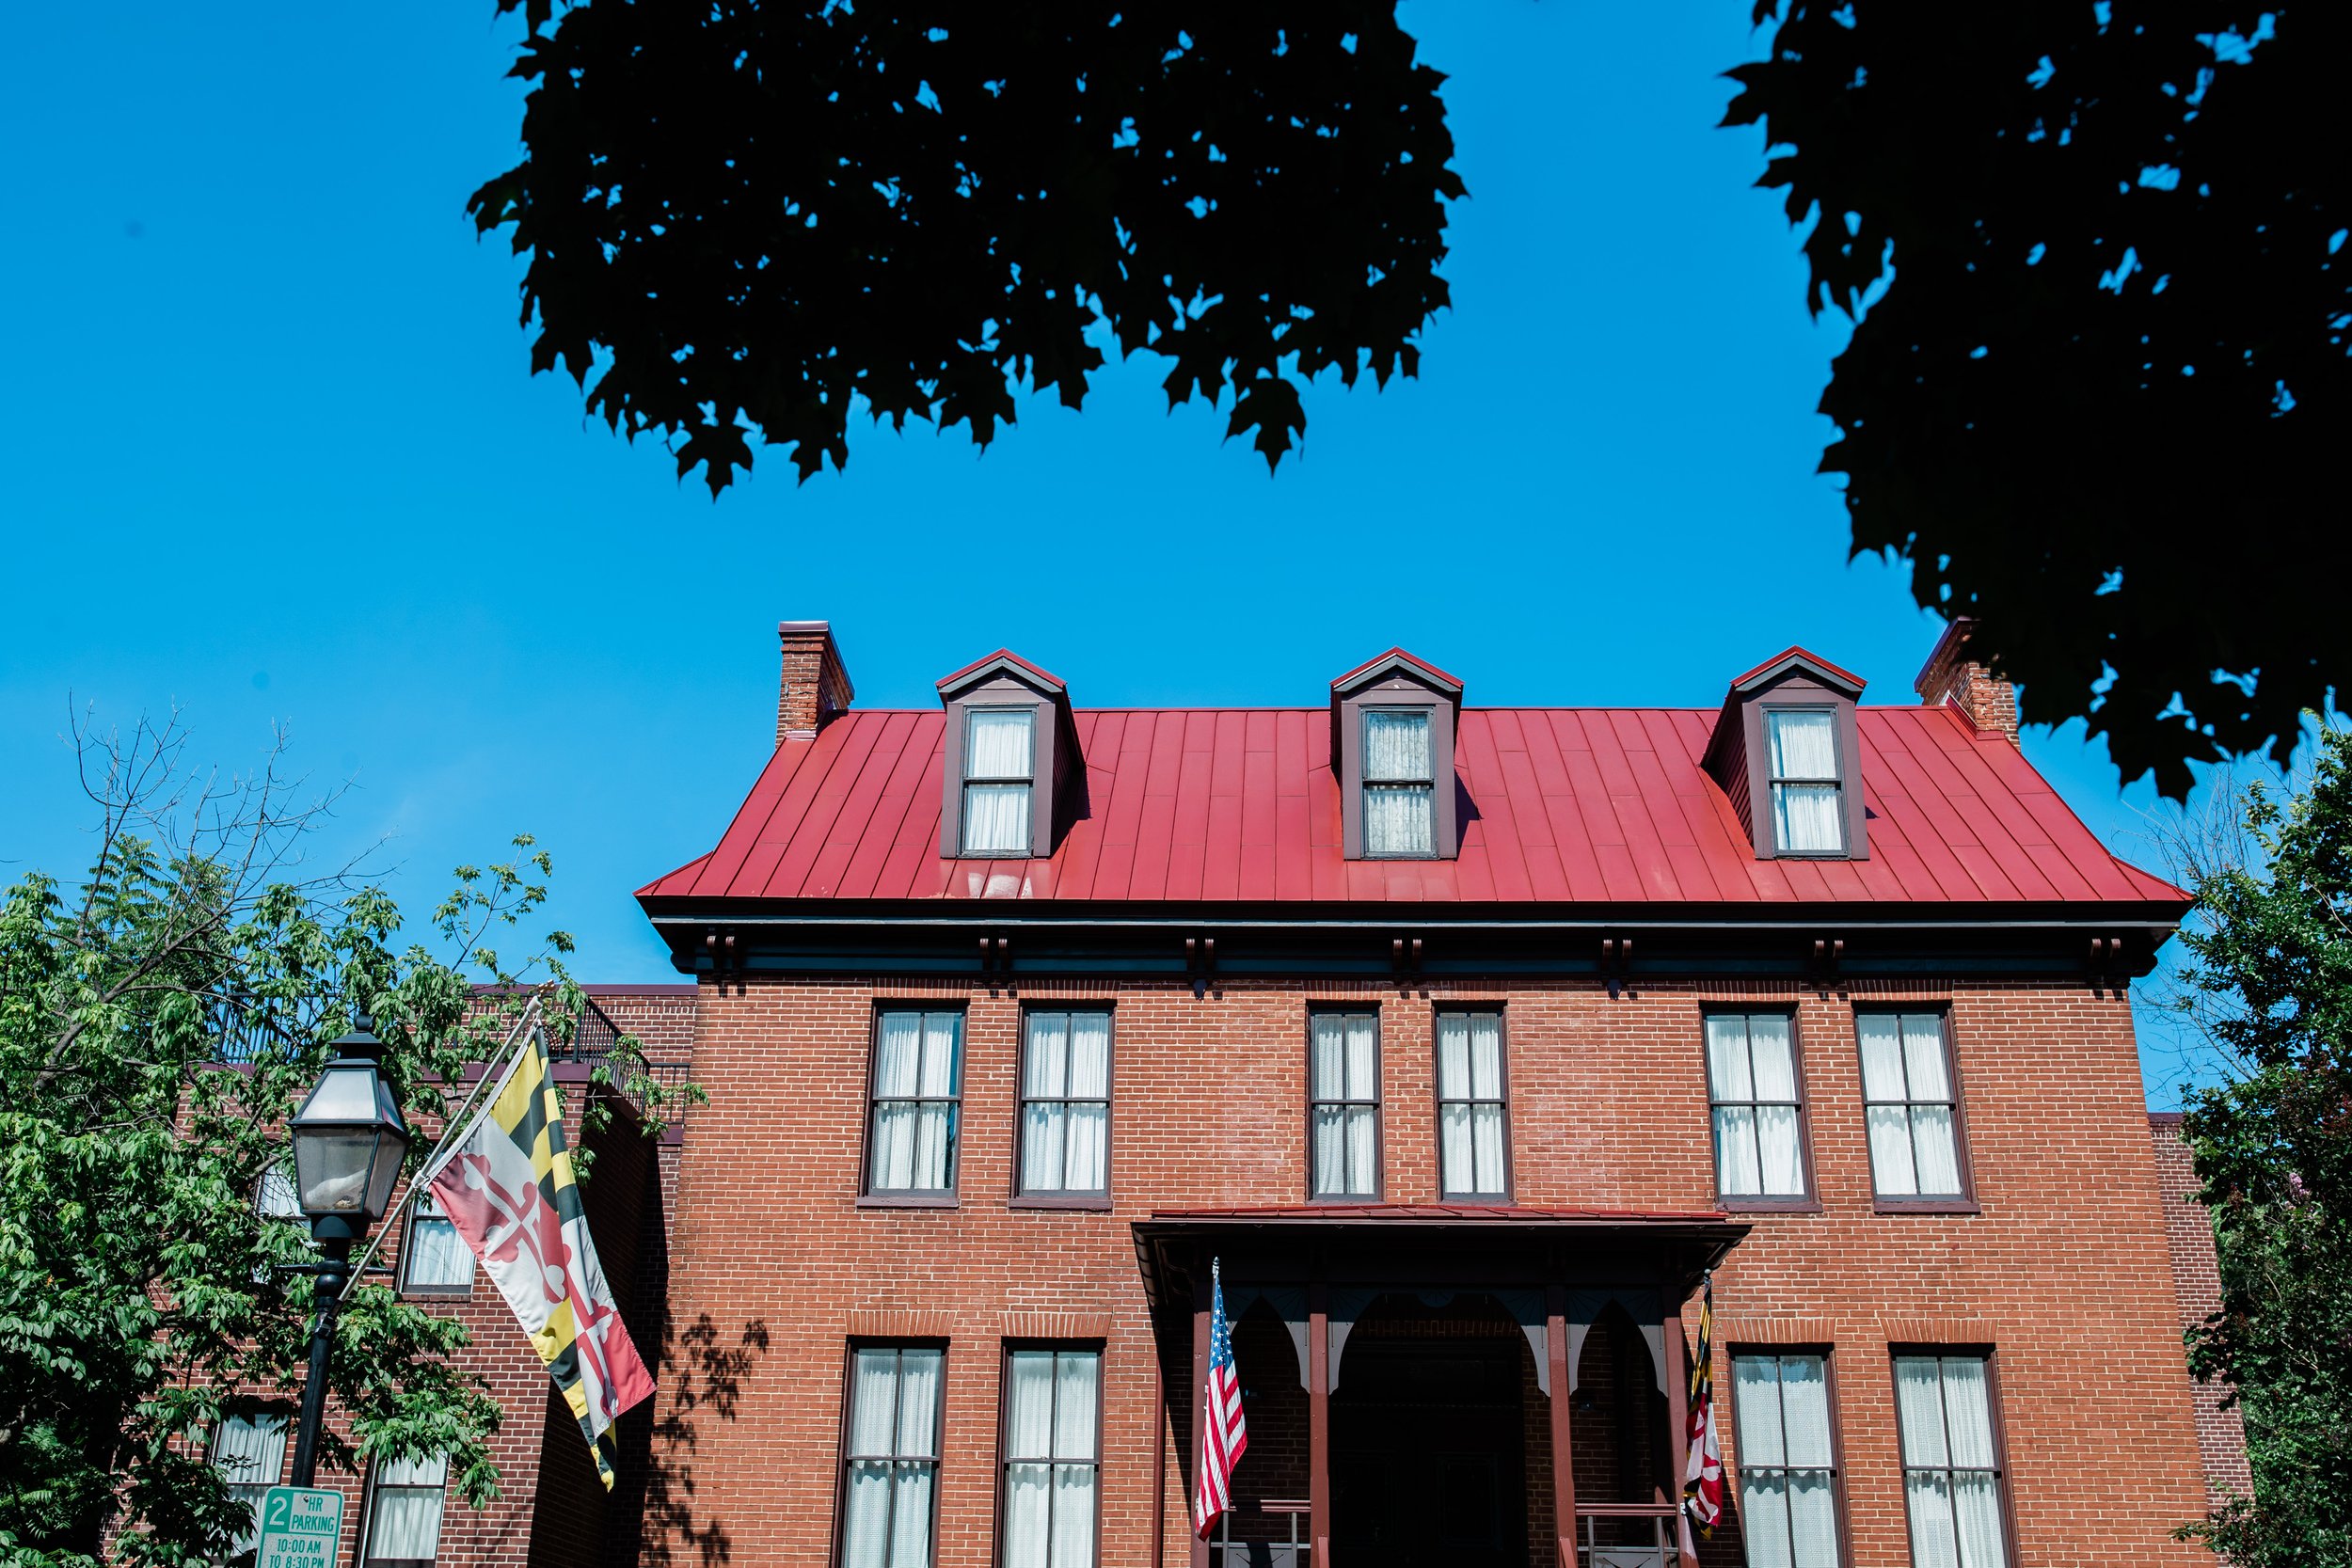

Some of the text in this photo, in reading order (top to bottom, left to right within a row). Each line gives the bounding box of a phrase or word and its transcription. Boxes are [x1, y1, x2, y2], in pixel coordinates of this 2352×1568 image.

[269, 1497, 323, 1526] 2 HR
[292, 1515, 334, 1531] PARKING
[278, 1539, 321, 1554] 10:00 AM
[270, 1555, 325, 1568] TO 8:30 PM
